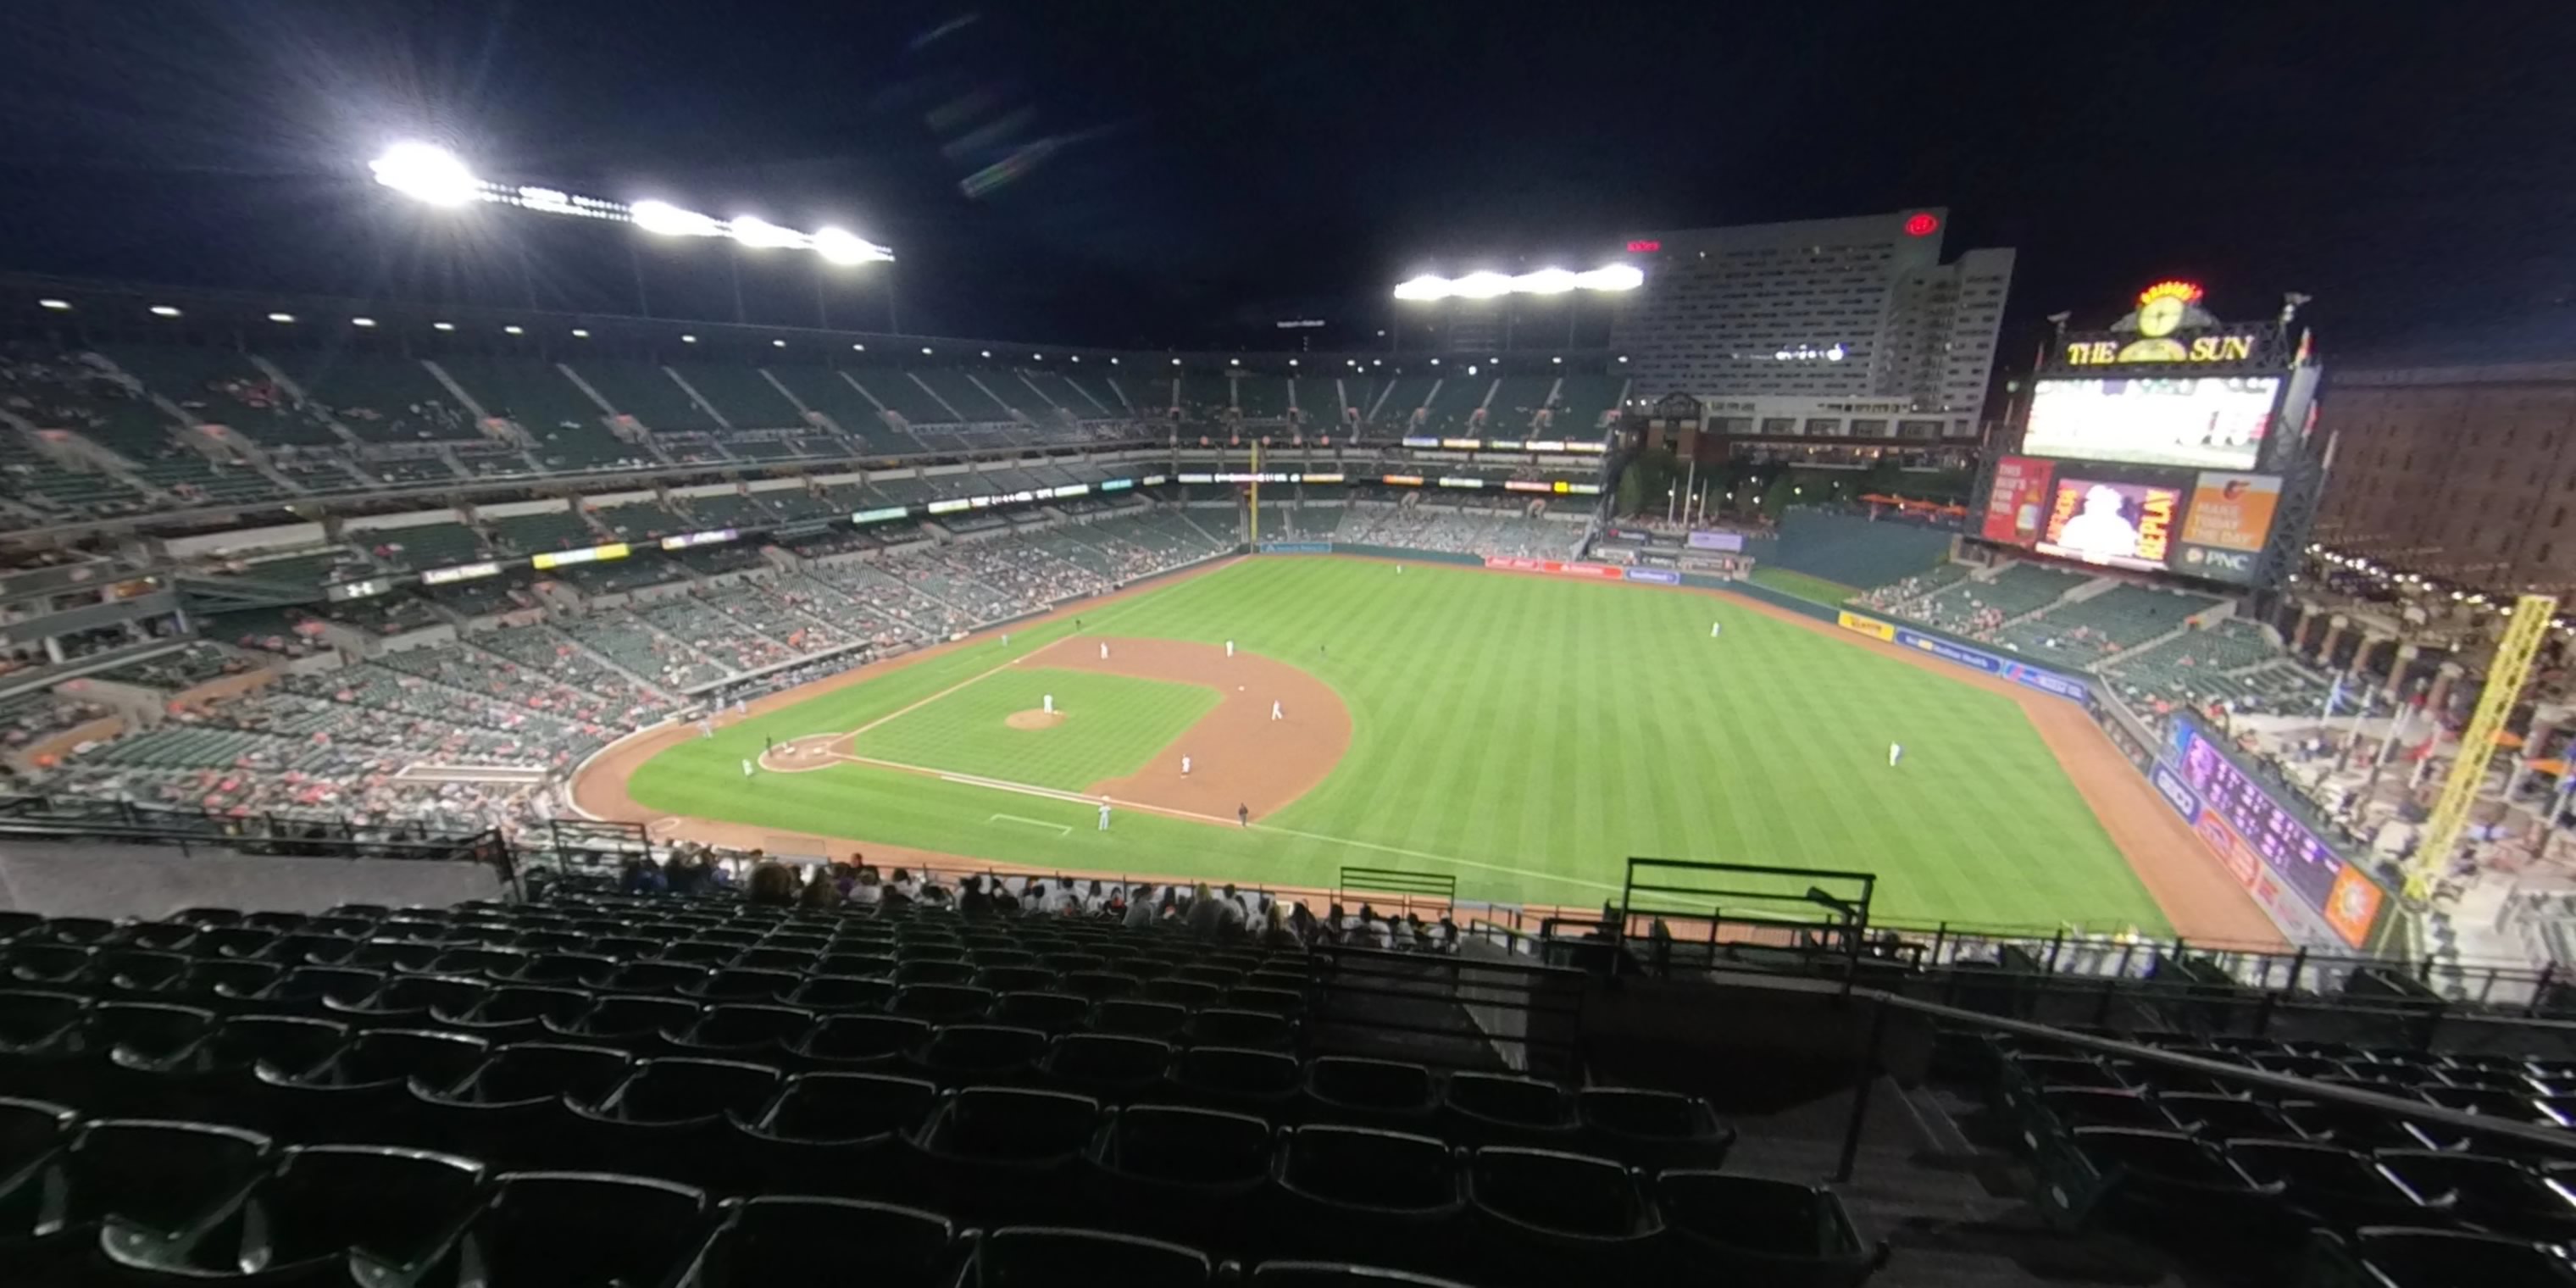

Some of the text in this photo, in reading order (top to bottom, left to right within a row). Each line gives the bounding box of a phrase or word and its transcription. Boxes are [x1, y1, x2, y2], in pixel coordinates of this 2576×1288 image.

[2067, 335, 2255, 365] THE SUN
[2134, 488, 2174, 560] REPLAY
[2205, 549, 2250, 571] PNC
